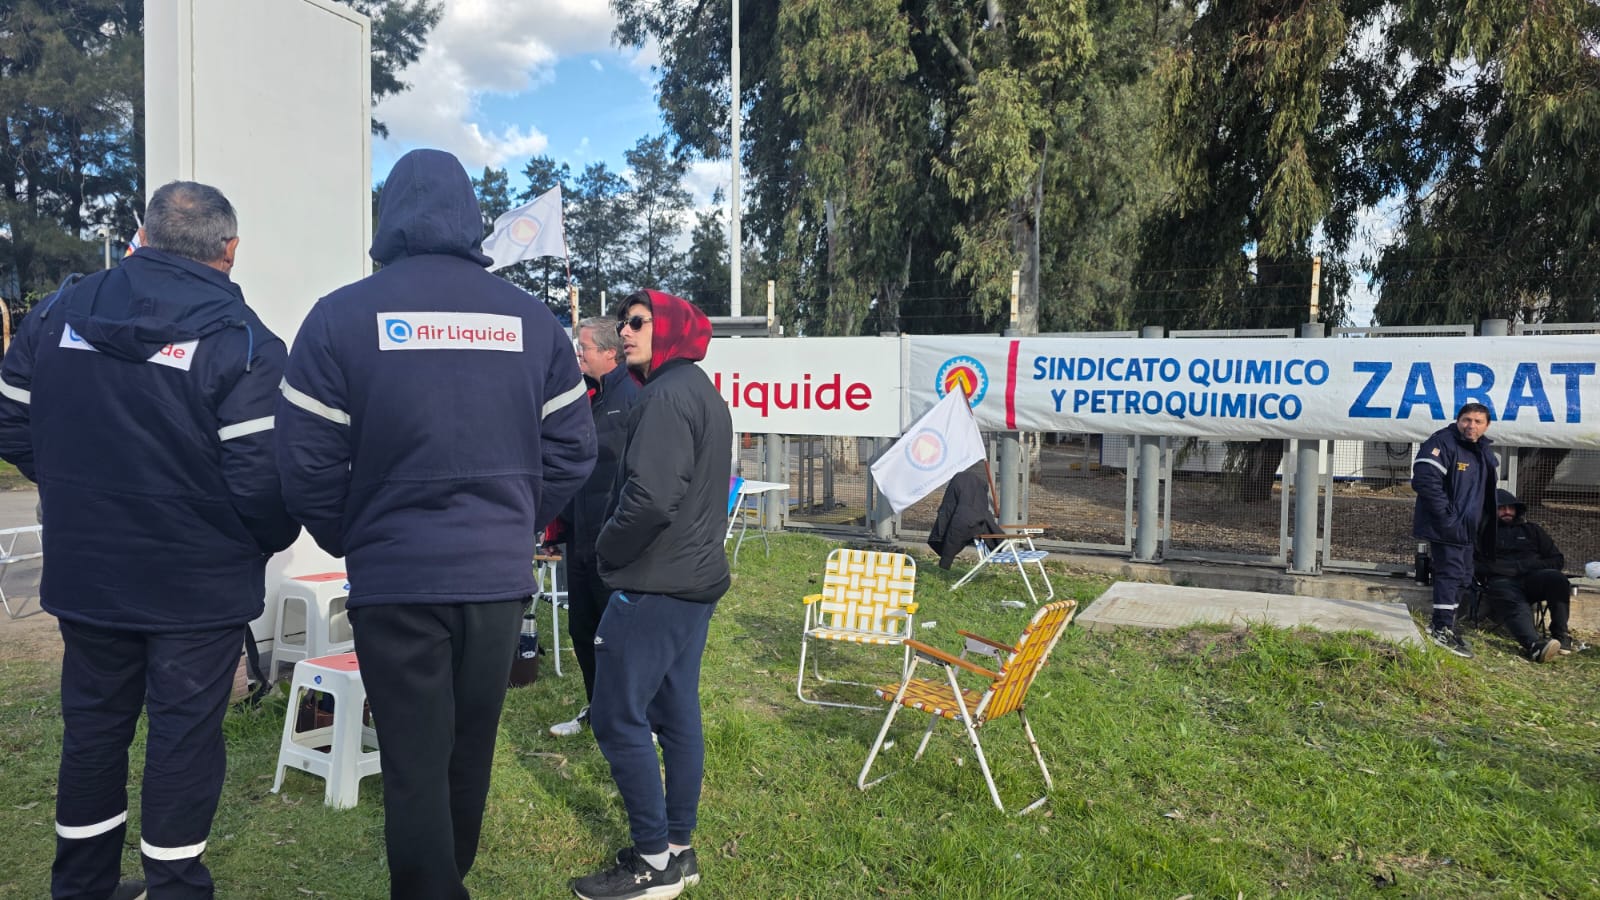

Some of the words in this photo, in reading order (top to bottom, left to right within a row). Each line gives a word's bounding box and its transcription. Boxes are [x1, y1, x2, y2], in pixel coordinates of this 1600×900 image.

[417, 325, 444, 340] Air
[447, 325, 517, 343] Liquide
[1033, 356, 1181, 383] SINDICATO
[1188, 358, 1330, 387] QUIMICO
[1051, 389, 1066, 413] Y
[1073, 389, 1303, 421] PETROQUIMICO
